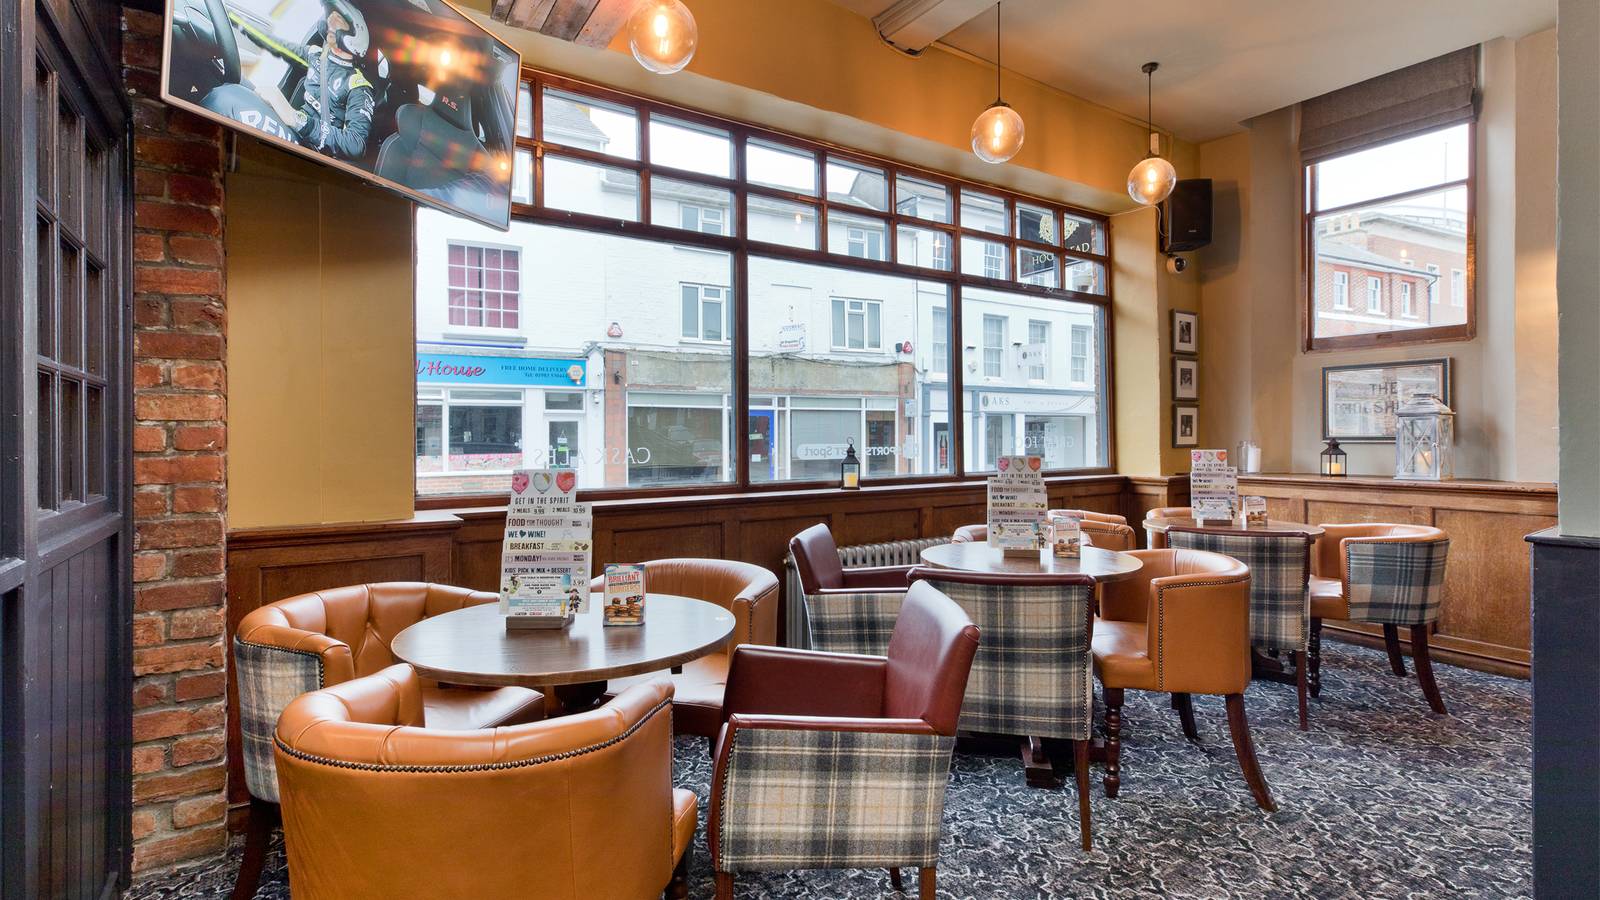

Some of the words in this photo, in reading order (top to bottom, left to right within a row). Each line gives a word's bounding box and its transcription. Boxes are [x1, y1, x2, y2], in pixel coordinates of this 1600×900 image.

[427, 359, 486, 377] House
[1369, 381, 1398, 395] THE
[507, 519, 525, 527] FOOD
[536, 519, 563, 527] THOUGHT
[508, 530, 518, 538] WE
[528, 530, 546, 538] WINE!
[509, 542, 544, 550] BREAKFAST
